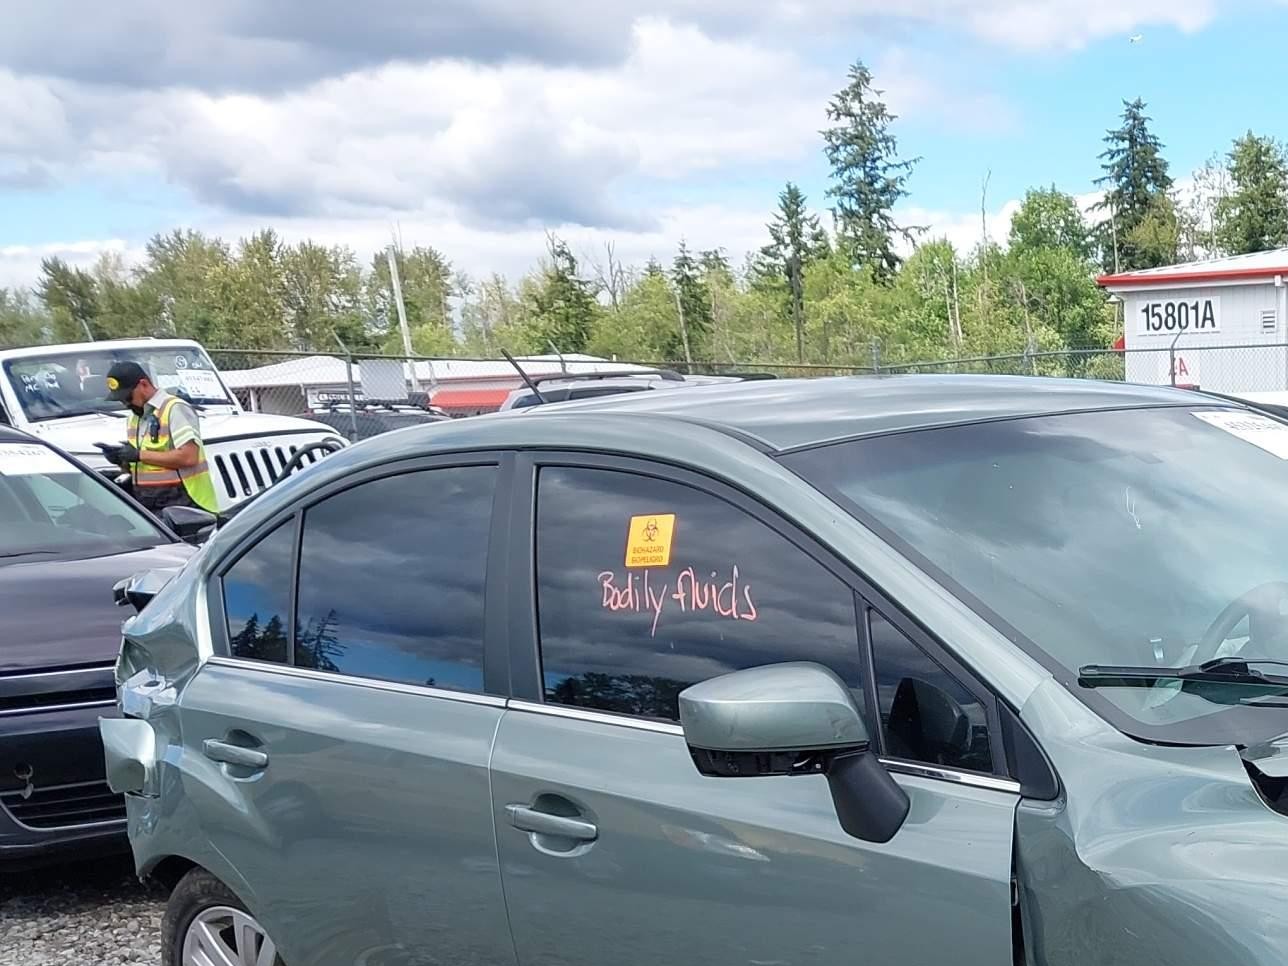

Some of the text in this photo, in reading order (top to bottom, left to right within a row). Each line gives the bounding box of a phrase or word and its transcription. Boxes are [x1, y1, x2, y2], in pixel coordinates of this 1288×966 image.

[1141, 300, 1216, 331] 15801A
[597, 565, 757, 637] Bodily fluids
